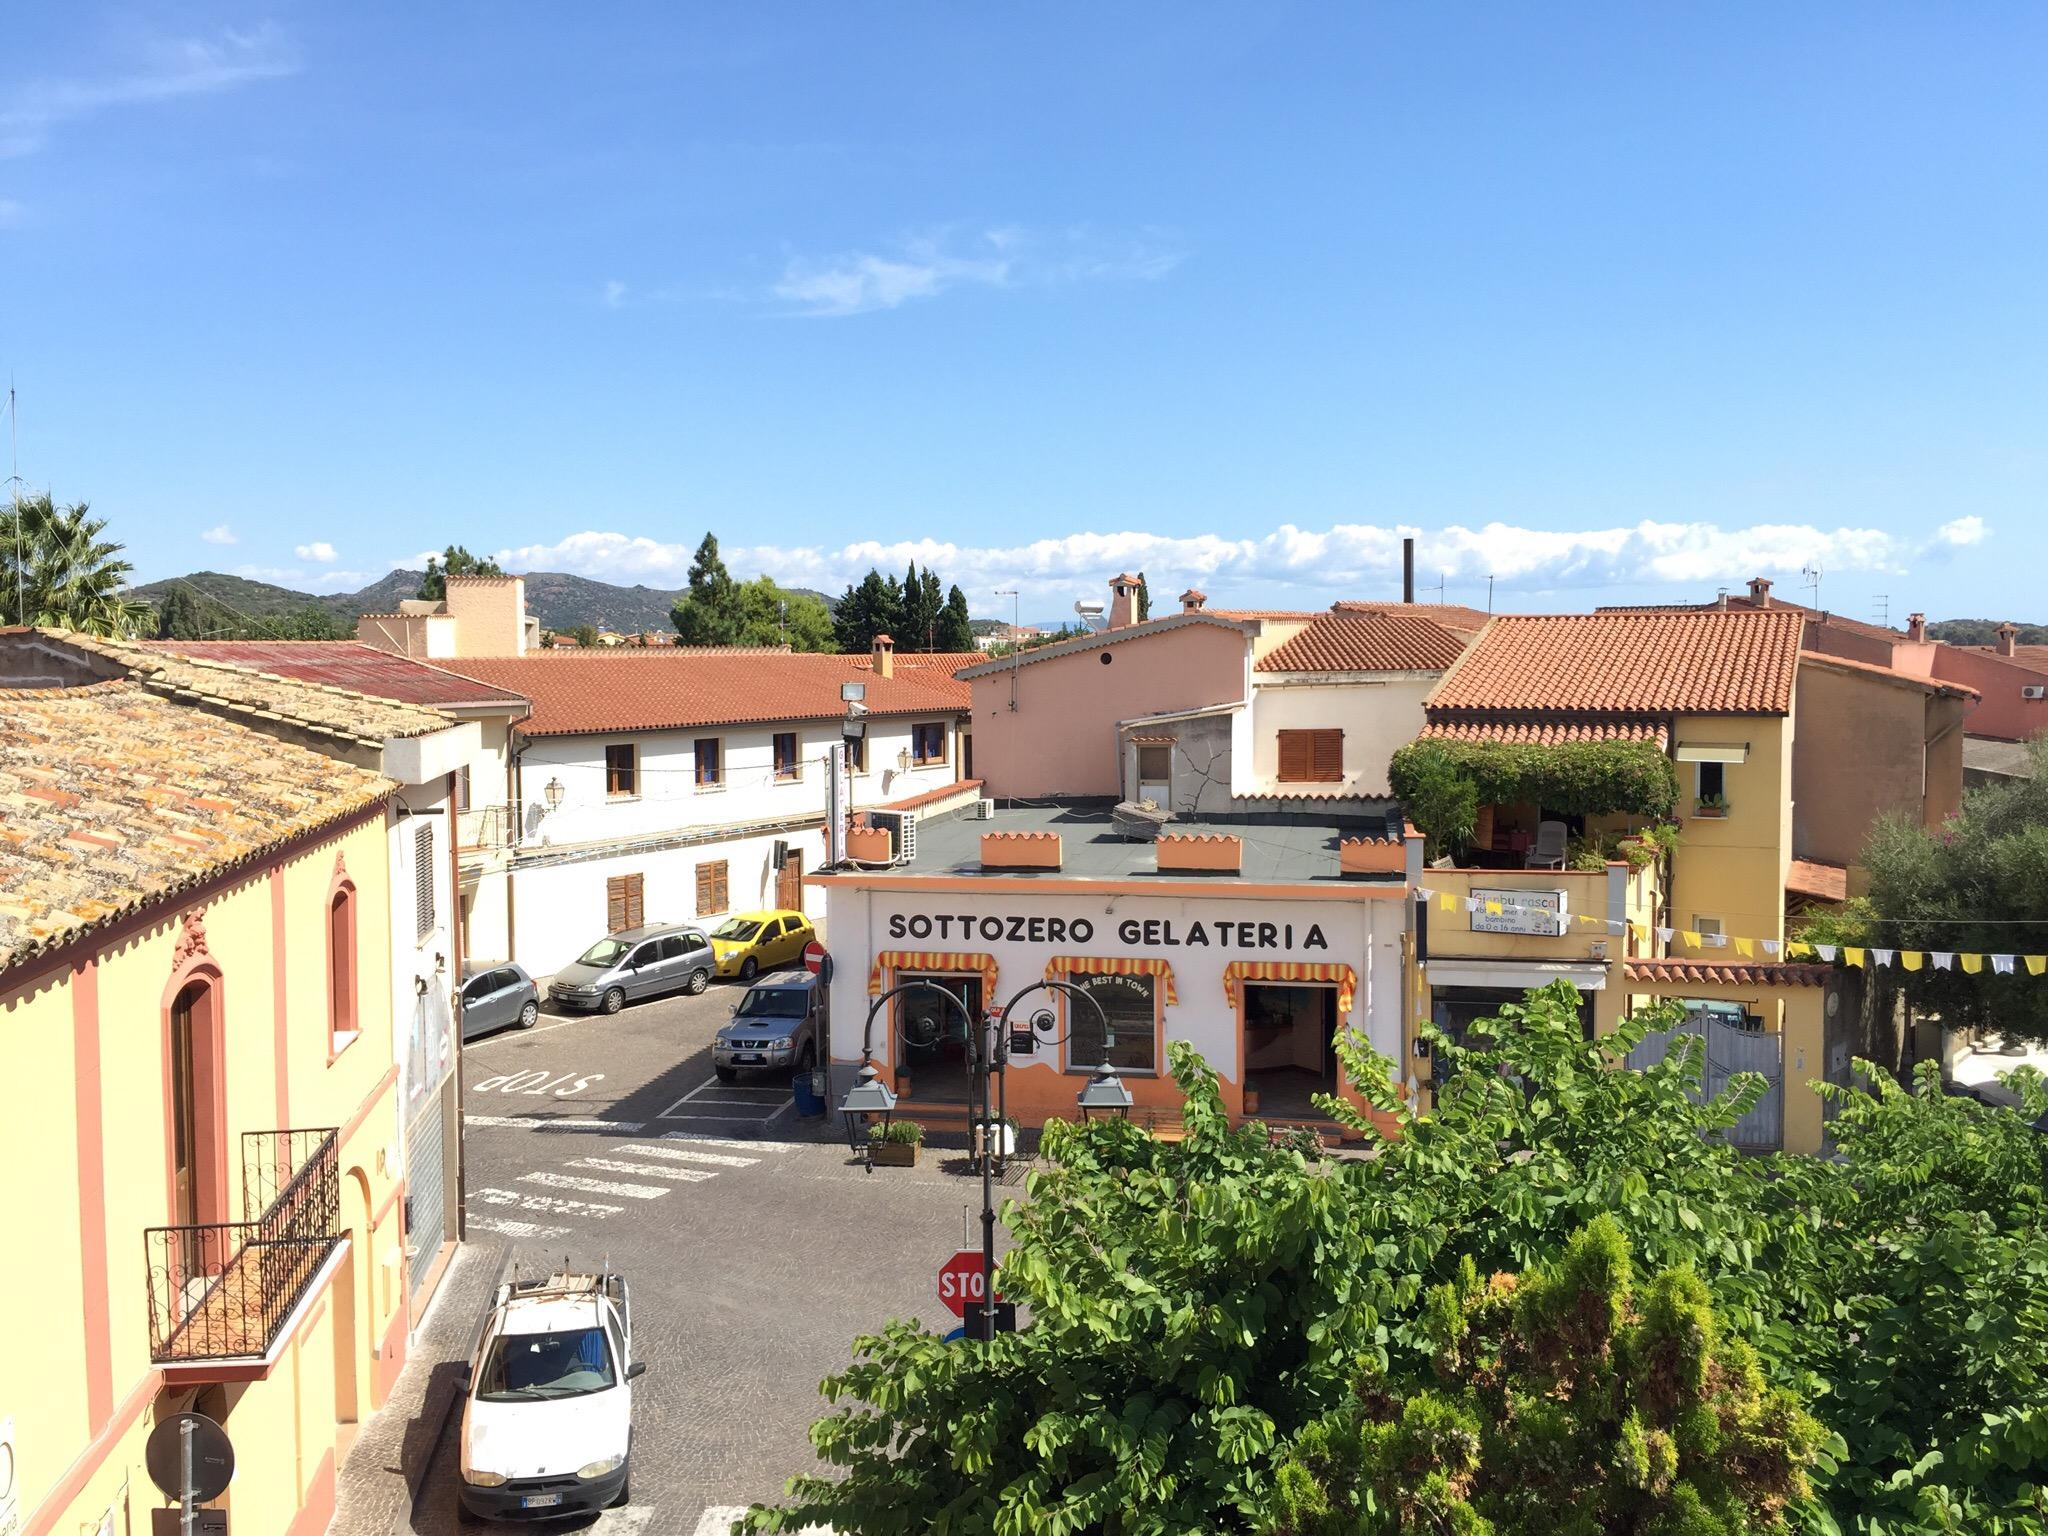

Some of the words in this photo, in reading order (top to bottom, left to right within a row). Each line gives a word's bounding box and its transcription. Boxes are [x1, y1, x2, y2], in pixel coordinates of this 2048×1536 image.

[889, 913, 1094, 943] SOTTOZERO
[1118, 919, 1328, 950] GELATERIA
[1092, 976, 1113, 986] BEST
[1115, 976, 1123, 985] IN
[1126, 978, 1150, 998] TOWN
[472, 1069, 605, 1096] STOP
[941, 1272, 985, 1298] STO
